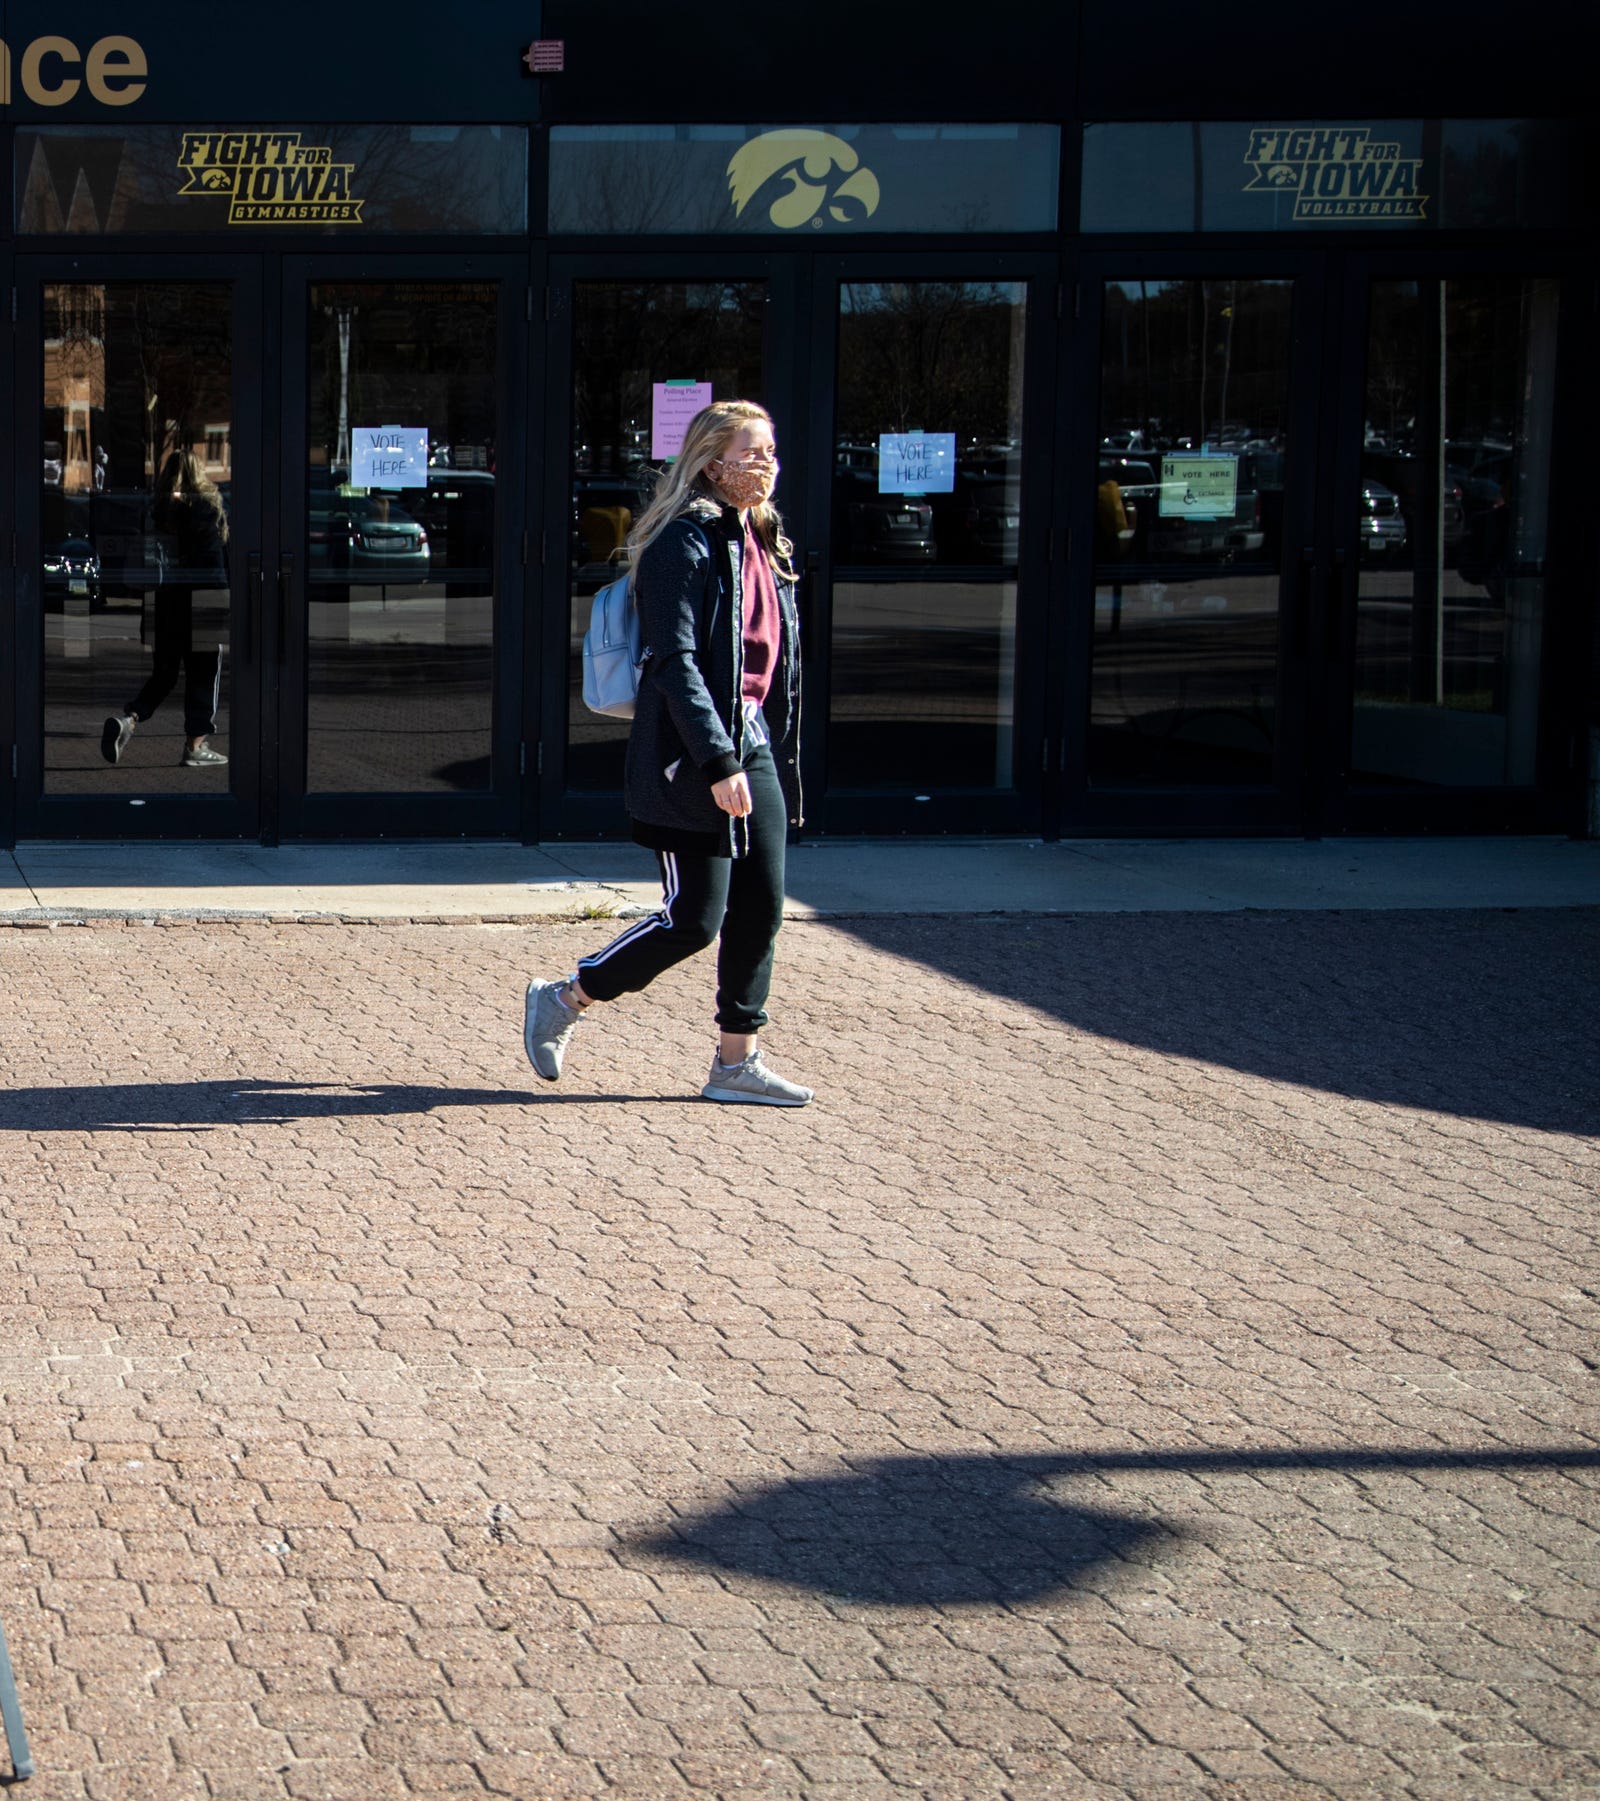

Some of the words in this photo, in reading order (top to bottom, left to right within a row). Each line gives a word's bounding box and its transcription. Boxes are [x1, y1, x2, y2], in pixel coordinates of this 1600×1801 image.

[179, 135, 299, 164] FIGHT
[293, 149, 331, 164] FOR
[1246, 131, 1367, 160] FIGHT
[1361, 145, 1398, 160] FOR
[235, 166, 348, 200] IOWA
[1302, 162, 1415, 196] IOWA
[235, 206, 351, 219] GYMNASTICS
[1301, 202, 1414, 214] VOLLEYBALL
[370, 434, 405, 448] VOTE
[897, 442, 932, 461] VOTE
[372, 459, 407, 477] HERE
[896, 464, 933, 484] HERE
